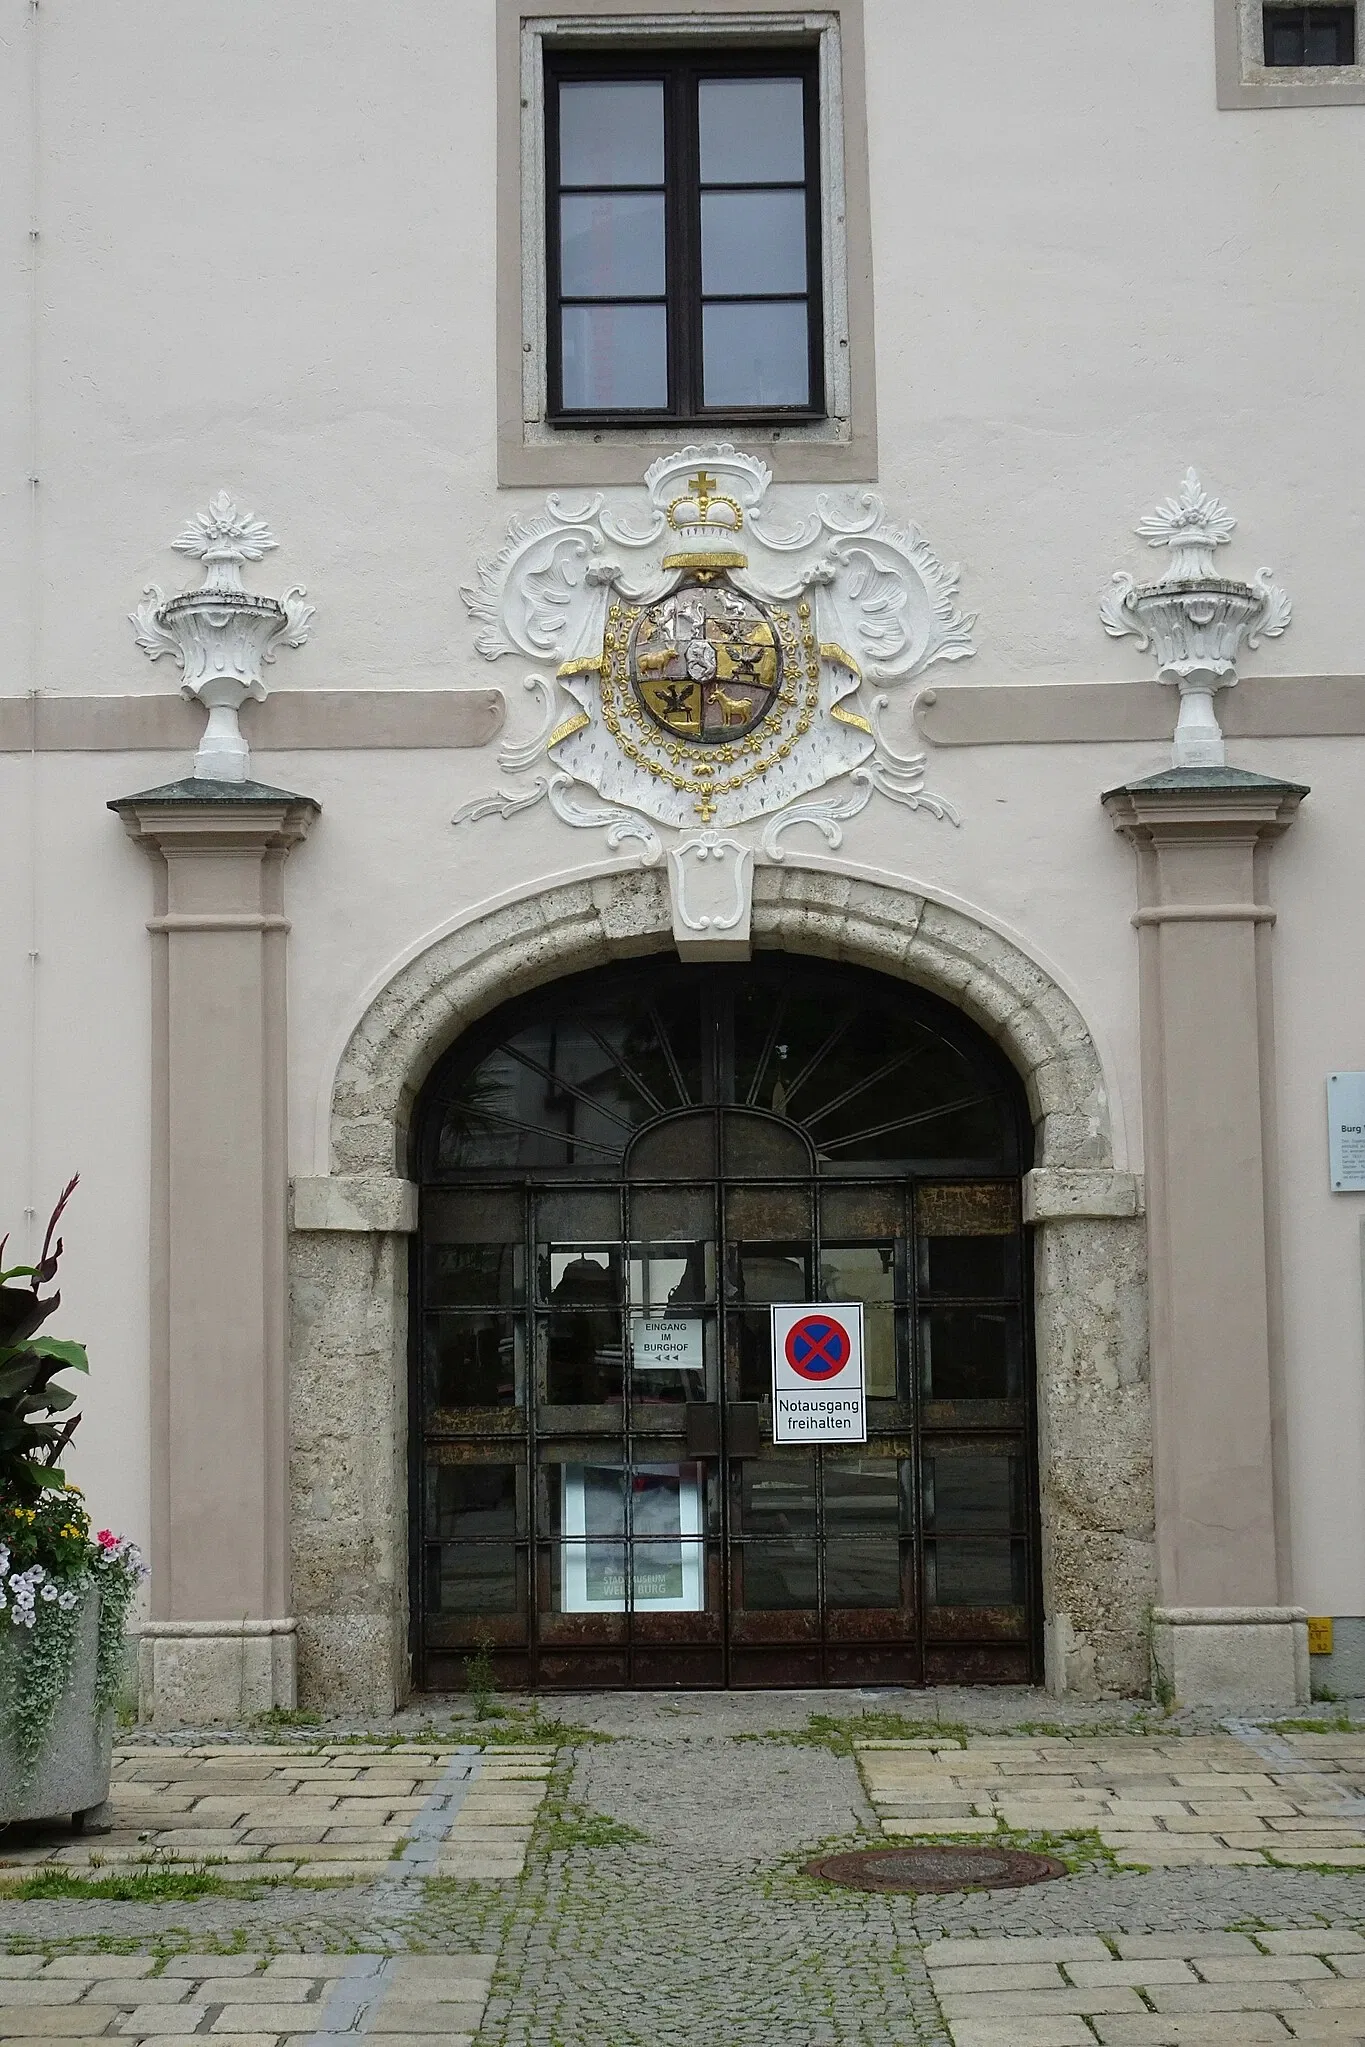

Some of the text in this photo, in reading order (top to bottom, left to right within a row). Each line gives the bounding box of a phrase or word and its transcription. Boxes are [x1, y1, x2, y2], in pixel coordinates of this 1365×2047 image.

[1341, 1125, 1362, 1134] Burg
[645, 1323, 687, 1331] EINGANG
[661, 1333, 672, 1341] IM
[643, 1343, 689, 1352] BURGHOF
[779, 1399, 859, 1414] Notausgang
[788, 1416, 851, 1429] freihalten
[637, 1583, 666, 1594] BURG
